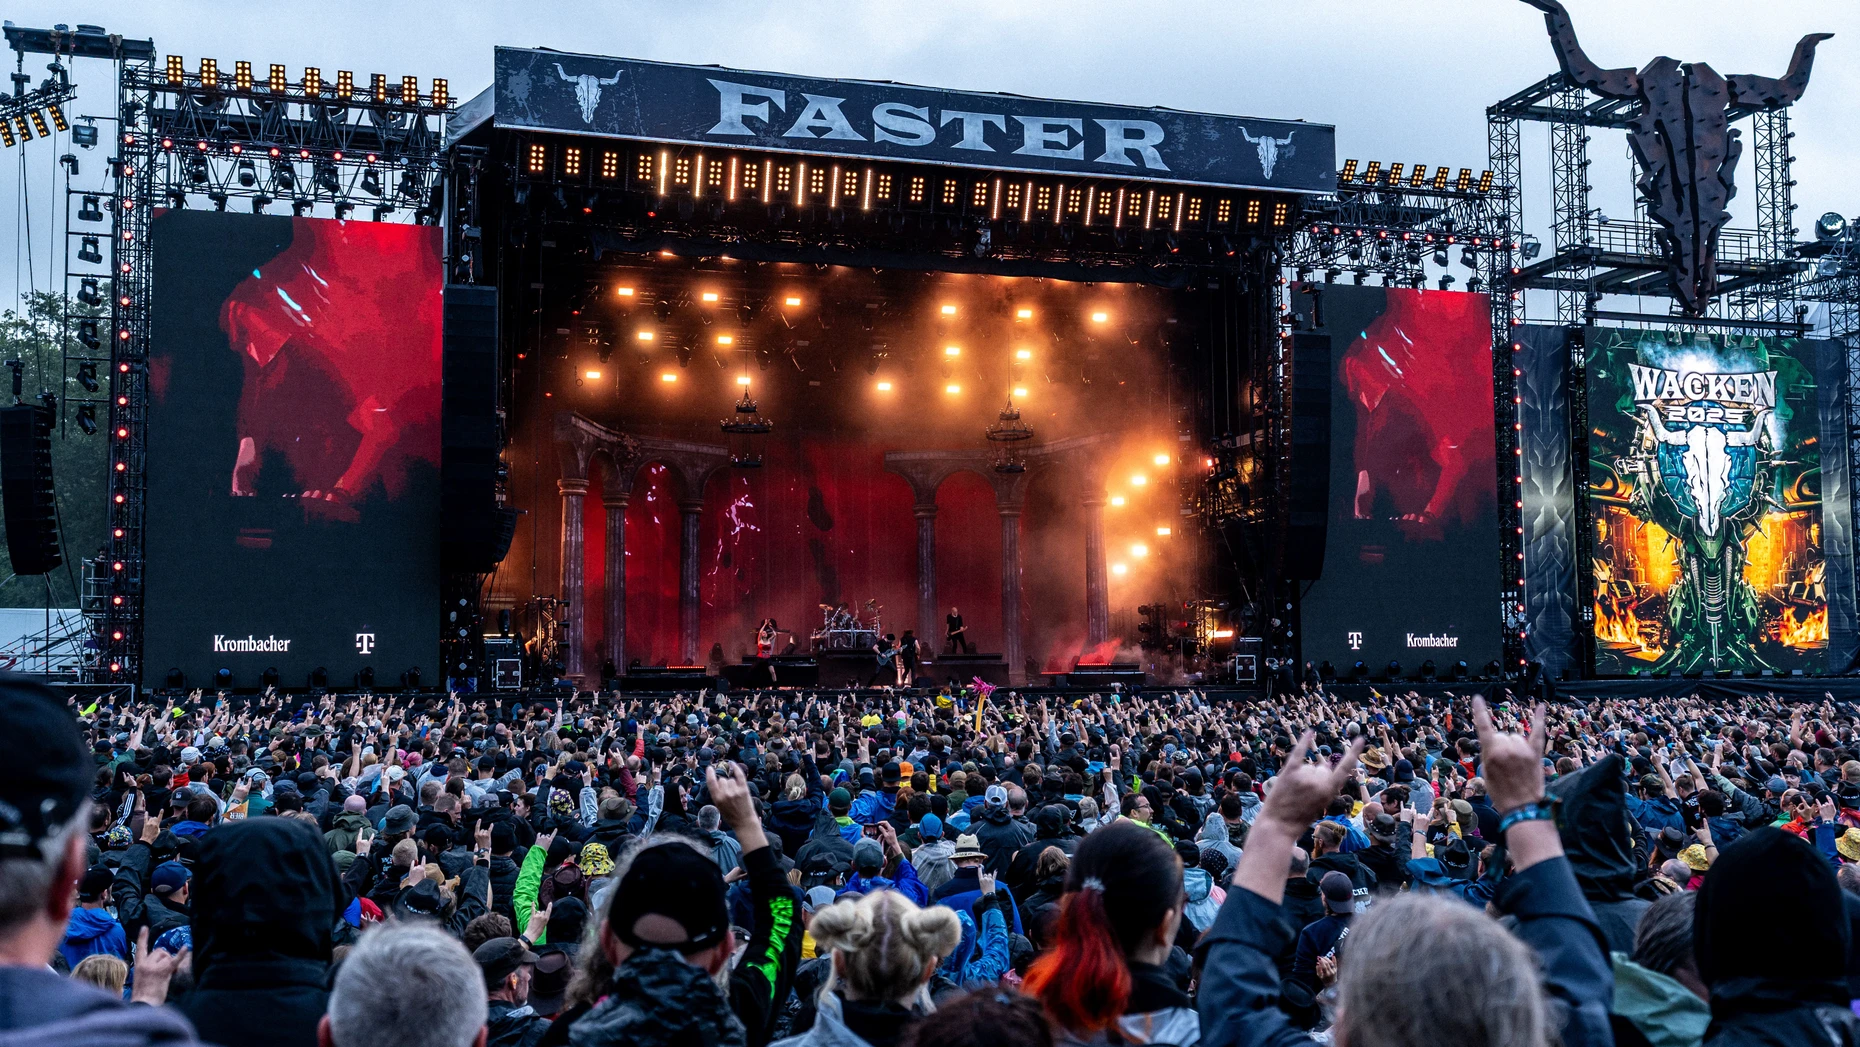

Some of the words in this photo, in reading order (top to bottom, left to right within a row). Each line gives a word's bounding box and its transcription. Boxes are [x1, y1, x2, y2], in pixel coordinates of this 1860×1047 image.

[705, 78, 1171, 172] FASTER
[1627, 363, 1778, 408] WACKEN
[1665, 406, 1748, 424] 2025
[214, 634, 291, 652] Krombacher
[355, 633, 375, 654] T
[1348, 631, 1362, 650] T
[1406, 632, 1459, 648] Krombacher
